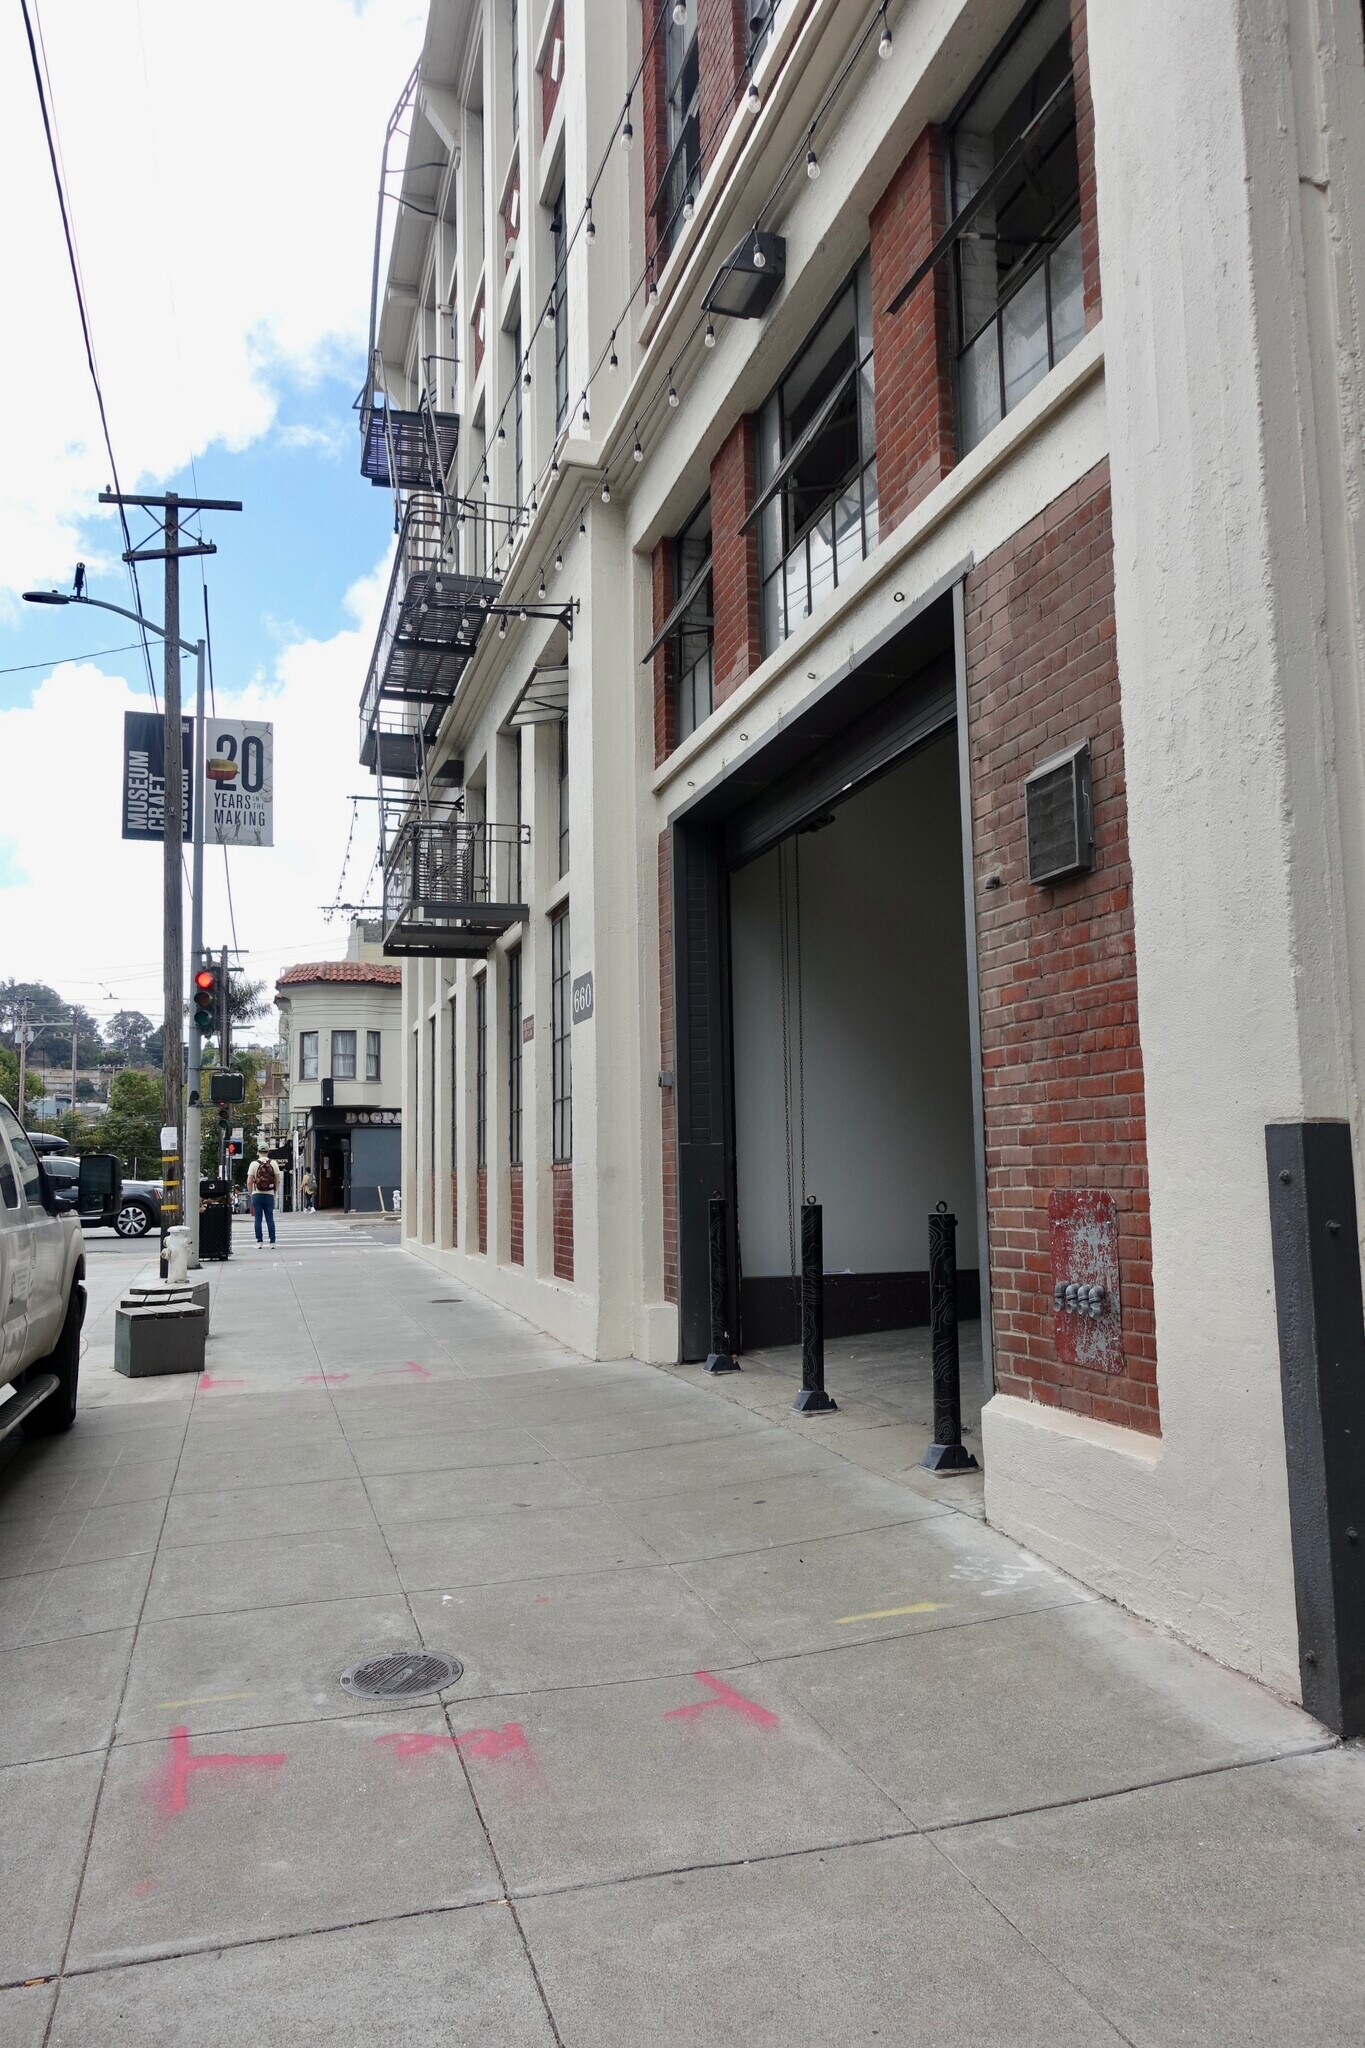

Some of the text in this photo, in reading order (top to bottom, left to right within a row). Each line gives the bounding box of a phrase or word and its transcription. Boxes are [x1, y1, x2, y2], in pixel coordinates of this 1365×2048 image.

[215, 734, 264, 793] 20
[127, 750, 149, 830] MUSEUM
[147, 773, 166, 831] CRAFT
[214, 793, 251, 810] YEARS
[214, 809, 266, 827] MAKING
[253, 802, 265, 810] THE
[574, 983, 592, 1013] 660
